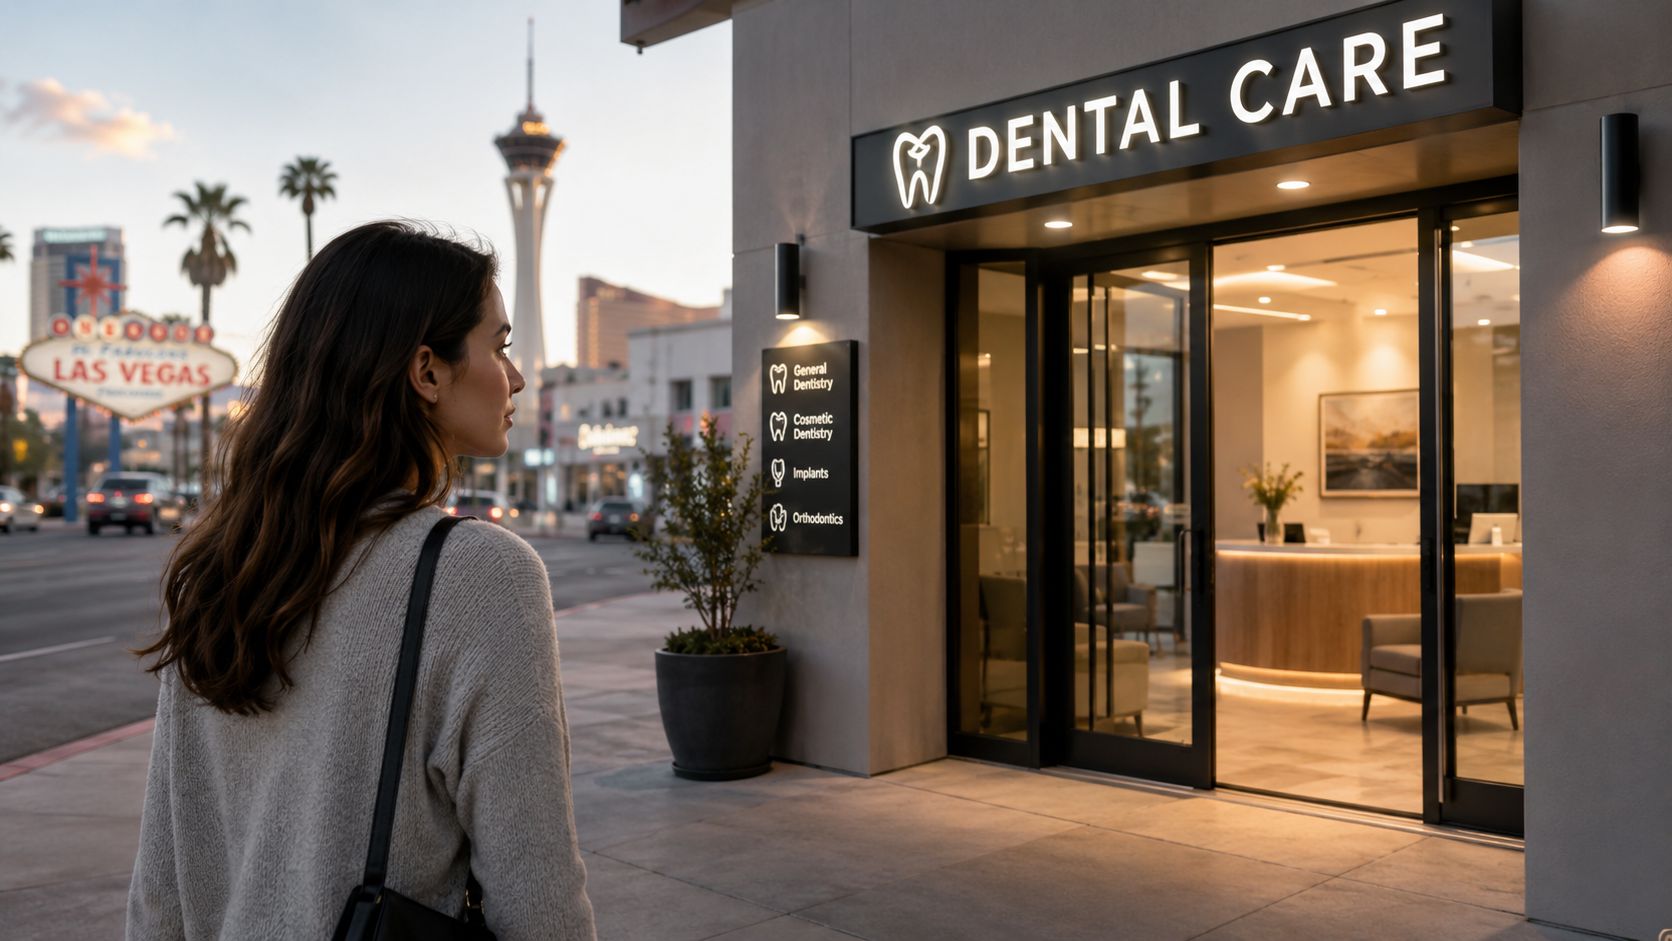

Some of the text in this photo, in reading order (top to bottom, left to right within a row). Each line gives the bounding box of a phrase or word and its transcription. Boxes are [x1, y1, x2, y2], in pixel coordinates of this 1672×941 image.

[968, 13, 1446, 181] DENTAL CARE
[54, 359, 211, 387] LAS VEGAS
[793, 362, 827, 376] General
[793, 378, 833, 391] Dentistry
[793, 412, 833, 425] Cosmetic
[793, 428, 833, 441] Dentistry
[793, 467, 829, 481] Implants
[793, 512, 843, 525] Orthodontics
